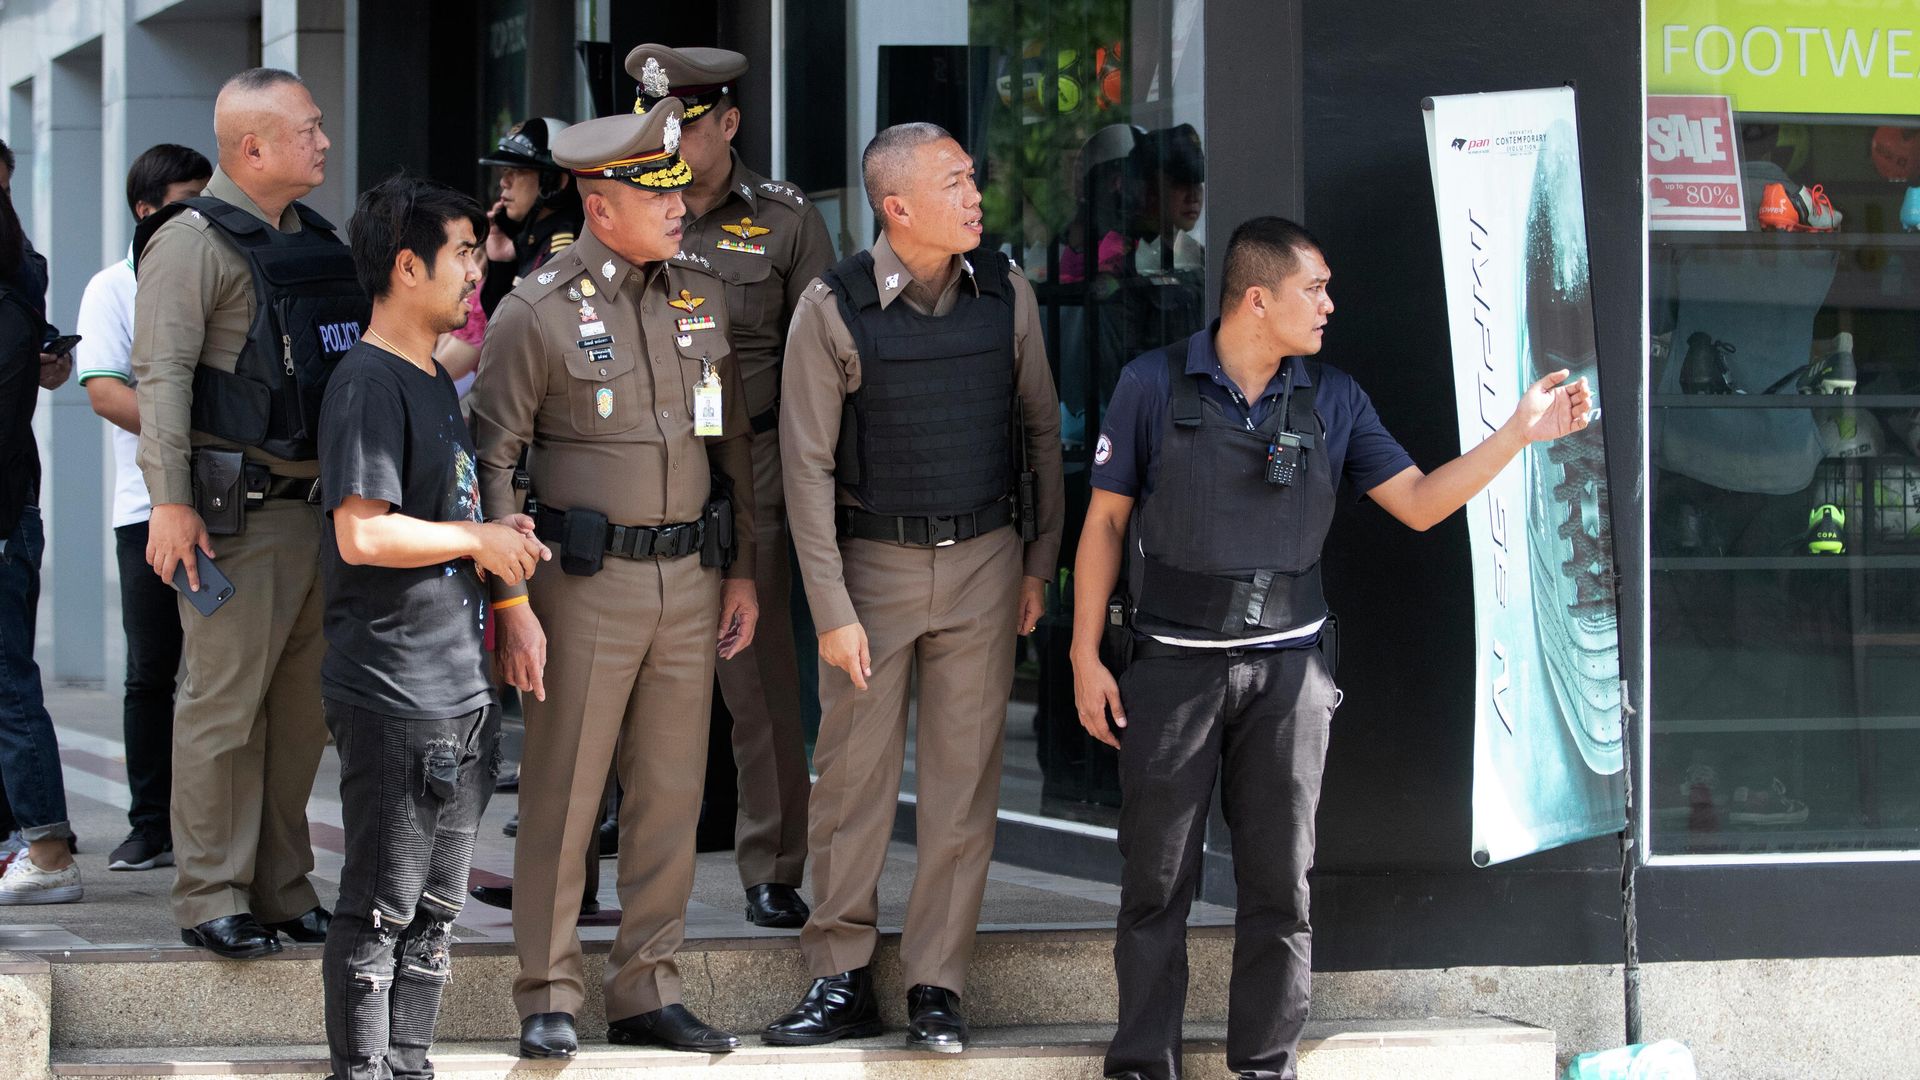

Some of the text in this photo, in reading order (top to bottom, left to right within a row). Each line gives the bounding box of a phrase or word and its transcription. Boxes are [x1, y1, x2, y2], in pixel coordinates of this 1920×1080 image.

[1663, 24, 1920, 78] FOOTWE
[1468, 138, 1490, 151] pan
[1495, 134, 1547, 146] CONTEMPORARY
[1648, 114, 1727, 163] SALE
[1686, 185, 1734, 205] 80%
[1469, 208, 1509, 608] IMPUSE
